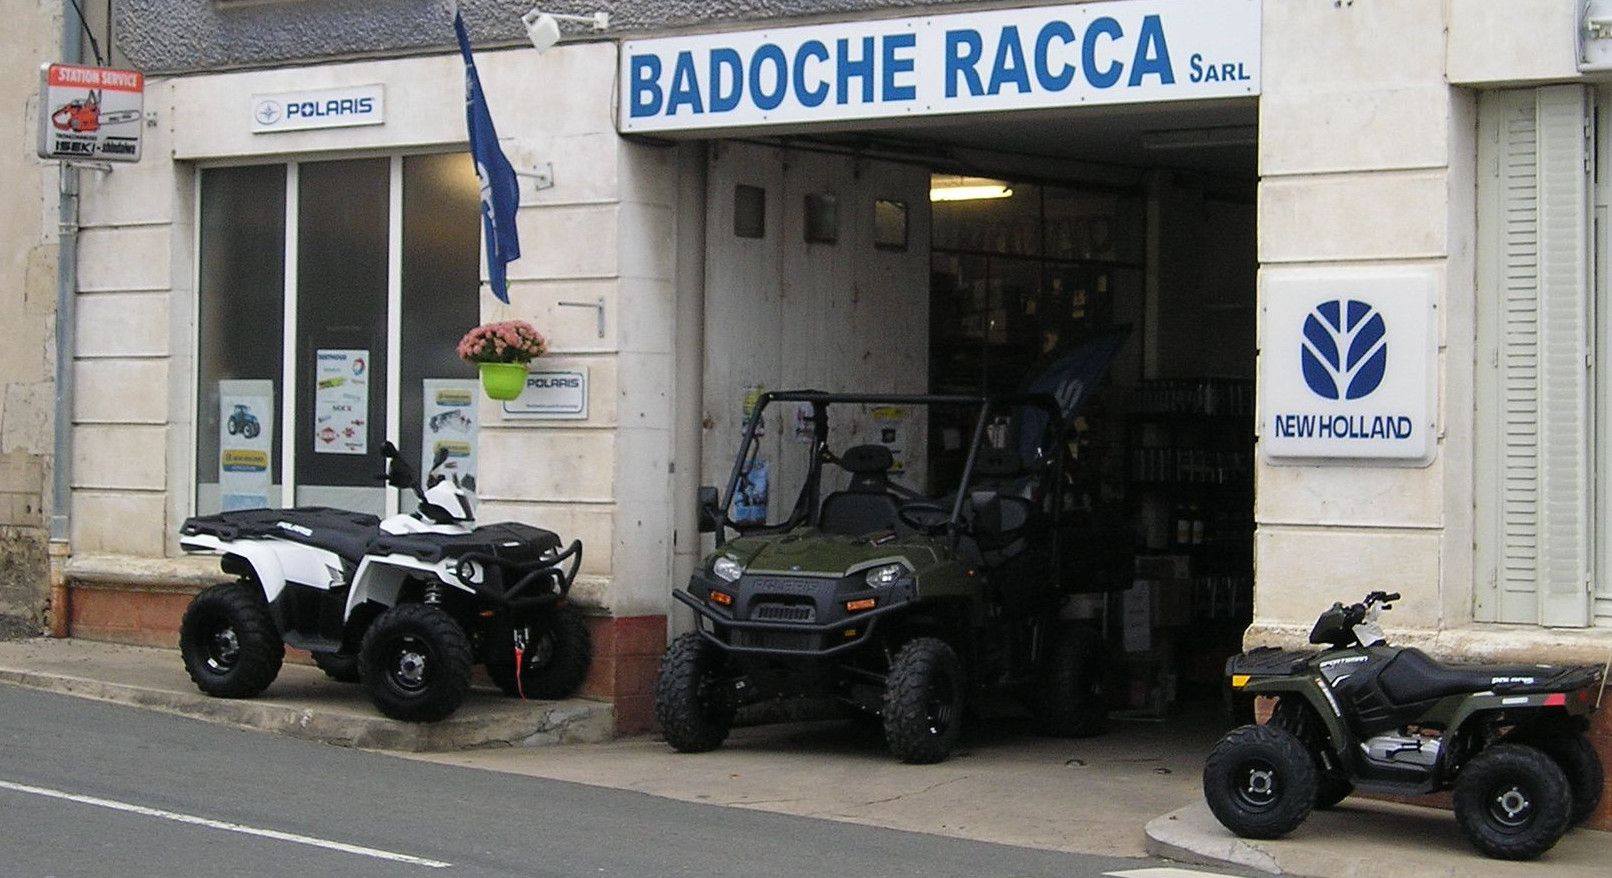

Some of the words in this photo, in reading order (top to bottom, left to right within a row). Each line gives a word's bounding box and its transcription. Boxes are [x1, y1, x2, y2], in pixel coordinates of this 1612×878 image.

[58, 68, 100, 82] STATION
[102, 71, 137, 87] SERVICE
[628, 33, 917, 119] BADOCHE
[944, 14, 1176, 98] RACCA
[1189, 52, 1251, 83] SARL
[286, 97, 373, 119] POLARIS
[527, 379, 579, 388] POLARIS
[1275, 414, 1316, 438] NEW
[1319, 415, 1412, 439] HOLLAND
